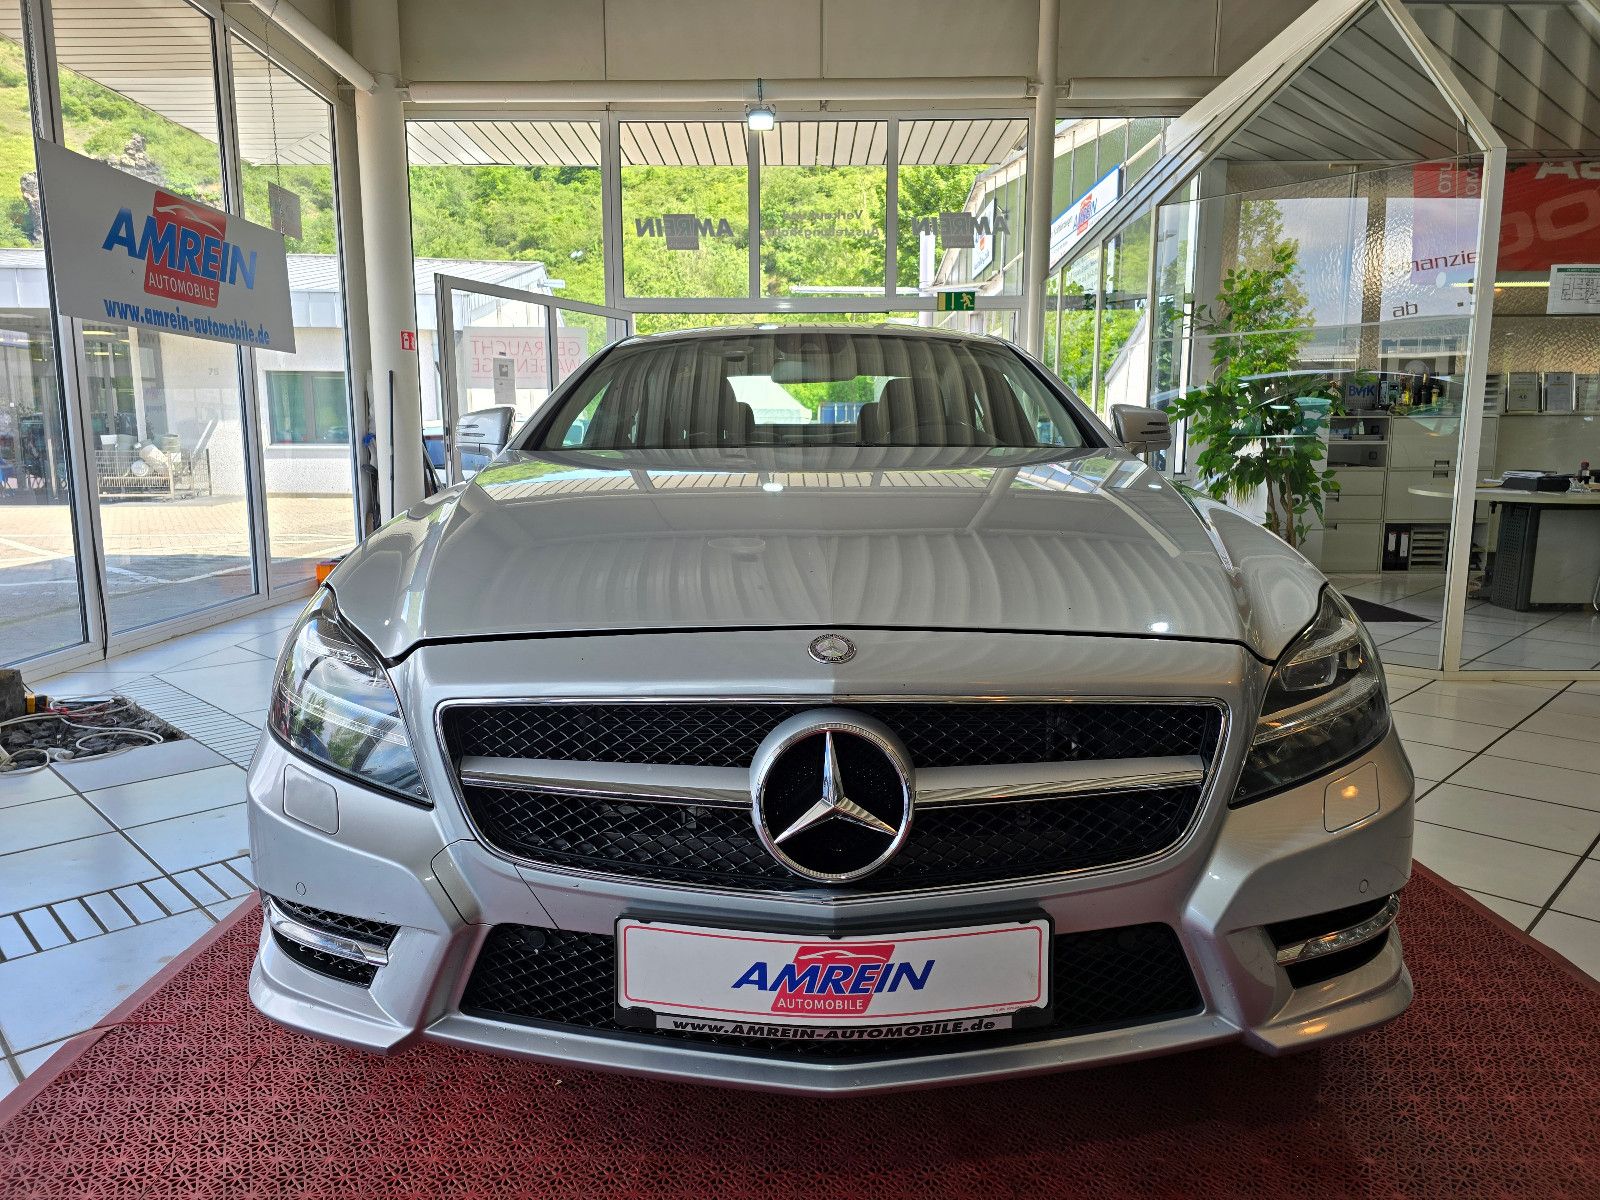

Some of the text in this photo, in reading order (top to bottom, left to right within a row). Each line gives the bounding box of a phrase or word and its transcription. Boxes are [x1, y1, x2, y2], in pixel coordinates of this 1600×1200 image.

[102, 207, 257, 290] AMREIN
[148, 272, 216, 302] AUTOMOBILE
[104, 298, 270, 345] www.amrein-automobile.de
[1392, 301, 1418, 318] ab
[730, 959, 936, 995] AMREIN
[777, 998, 864, 1011] AUTOMOBILE
[672, 1018, 996, 1040] www.AMREIN-AUTOMOBILE.de
